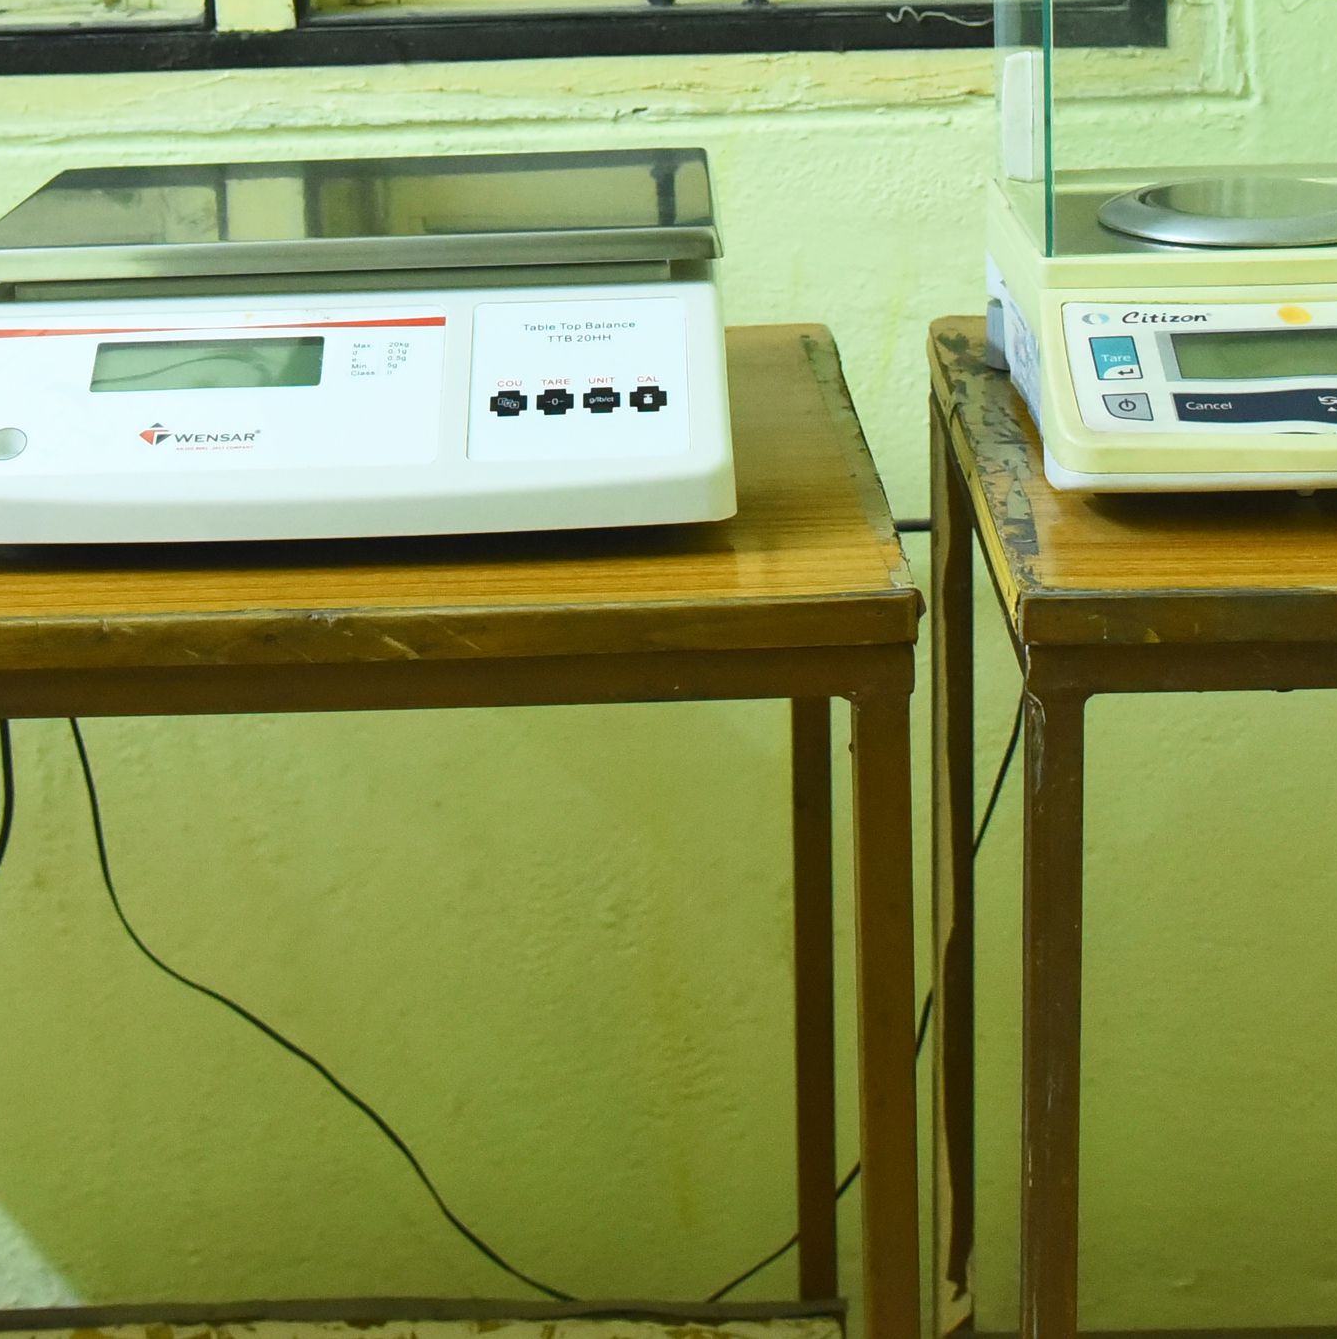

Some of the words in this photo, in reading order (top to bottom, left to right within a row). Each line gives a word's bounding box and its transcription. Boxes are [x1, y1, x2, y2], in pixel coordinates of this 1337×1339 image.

[1122, 311, 1207, 324] Citizon
[523, 323, 556, 332] Table
[560, 322, 582, 332] Top
[586, 321, 636, 330] Balance
[547, 335, 572, 343] TTB
[577, 334, 612, 342] 20HH
[1101, 354, 1132, 362] Tare
[541, 378, 571, 386] TARE
[637, 375, 660, 383] CAL
[588, 396, 615, 405] g/lb/ct
[1185, 401, 1233, 411] Cancel
[174, 433, 255, 443] WENSAR
